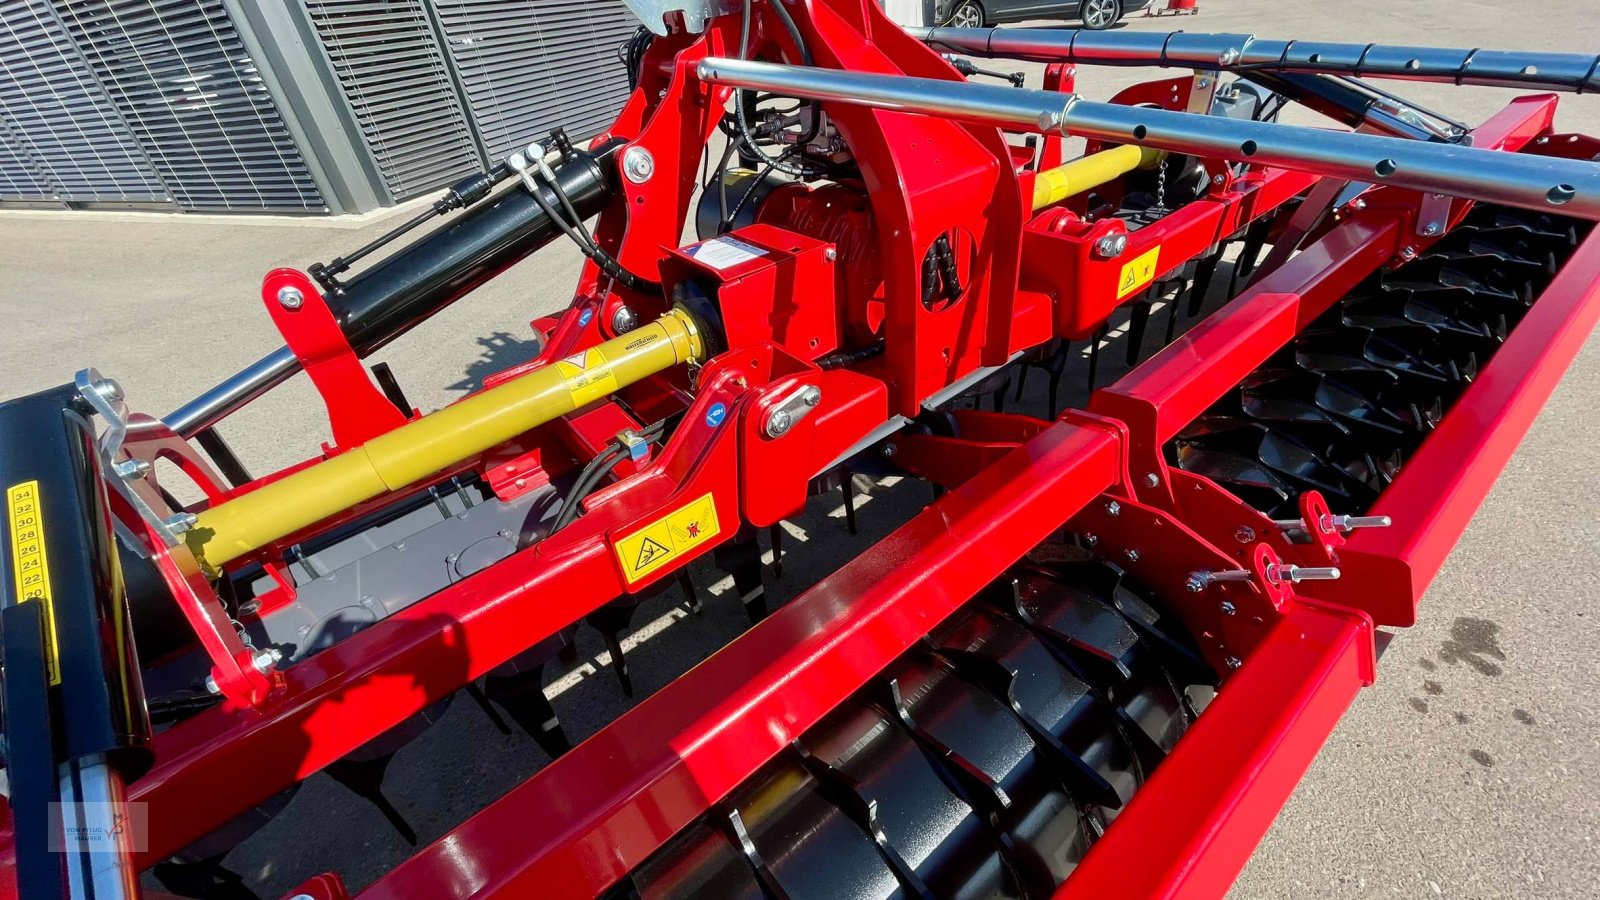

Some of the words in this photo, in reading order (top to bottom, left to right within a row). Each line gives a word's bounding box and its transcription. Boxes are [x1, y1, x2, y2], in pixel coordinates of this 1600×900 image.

[15, 491, 31, 501] 34
[17, 504, 32, 514] 32
[18, 517, 34, 527] 30
[19, 531, 35, 541] 28
[21, 545, 37, 555] 26
[22, 559, 38, 570] 24
[24, 574, 40, 585] 22
[26, 589, 42, 599] 20
